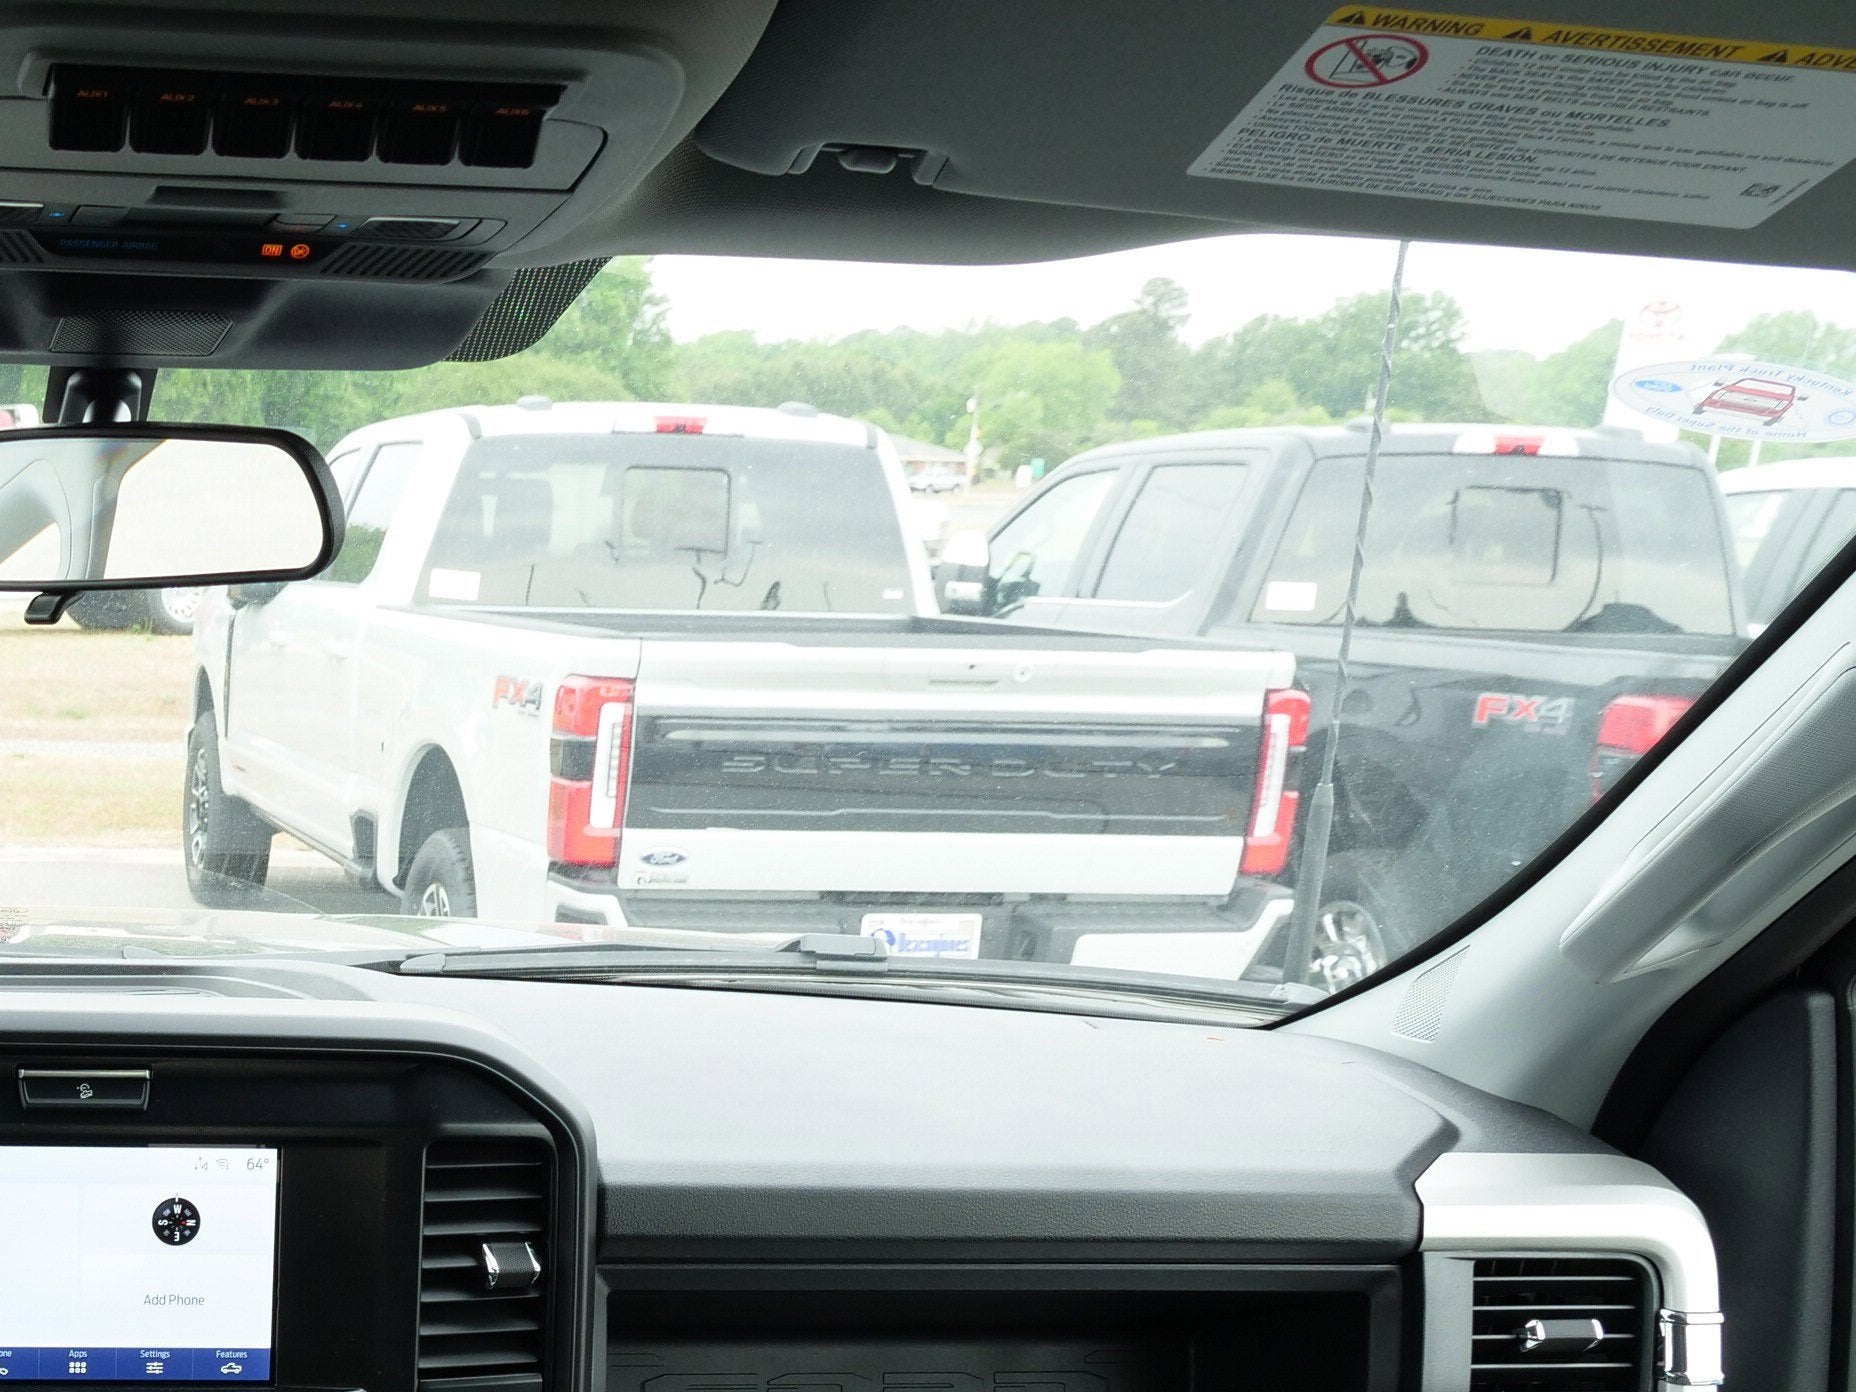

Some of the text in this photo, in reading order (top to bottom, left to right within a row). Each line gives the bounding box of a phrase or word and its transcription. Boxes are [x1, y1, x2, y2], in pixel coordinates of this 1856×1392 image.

[1371, 13, 1485, 36] WARNING
[1541, 29, 1746, 60] AVERTISSEMENT
[1475, 46, 1541, 61] DEATH
[1559, 54, 1640, 68] SERIOUS
[1642, 61, 1706, 75] INJURY
[59, 240, 120, 249] PASSENGER
[492, 674, 544, 711] FX4
[1470, 691, 1578, 730] FX4
[719, 753, 1178, 780] SUPER DUTY
[246, 1157, 270, 1171] 64°
[173, 1204, 183, 1214] W
[143, 1294, 205, 1306] Add Phone
[68, 1349, 88, 1360] Apps
[139, 1349, 171, 1360] Settings
[216, 1350, 248, 1358] Features
